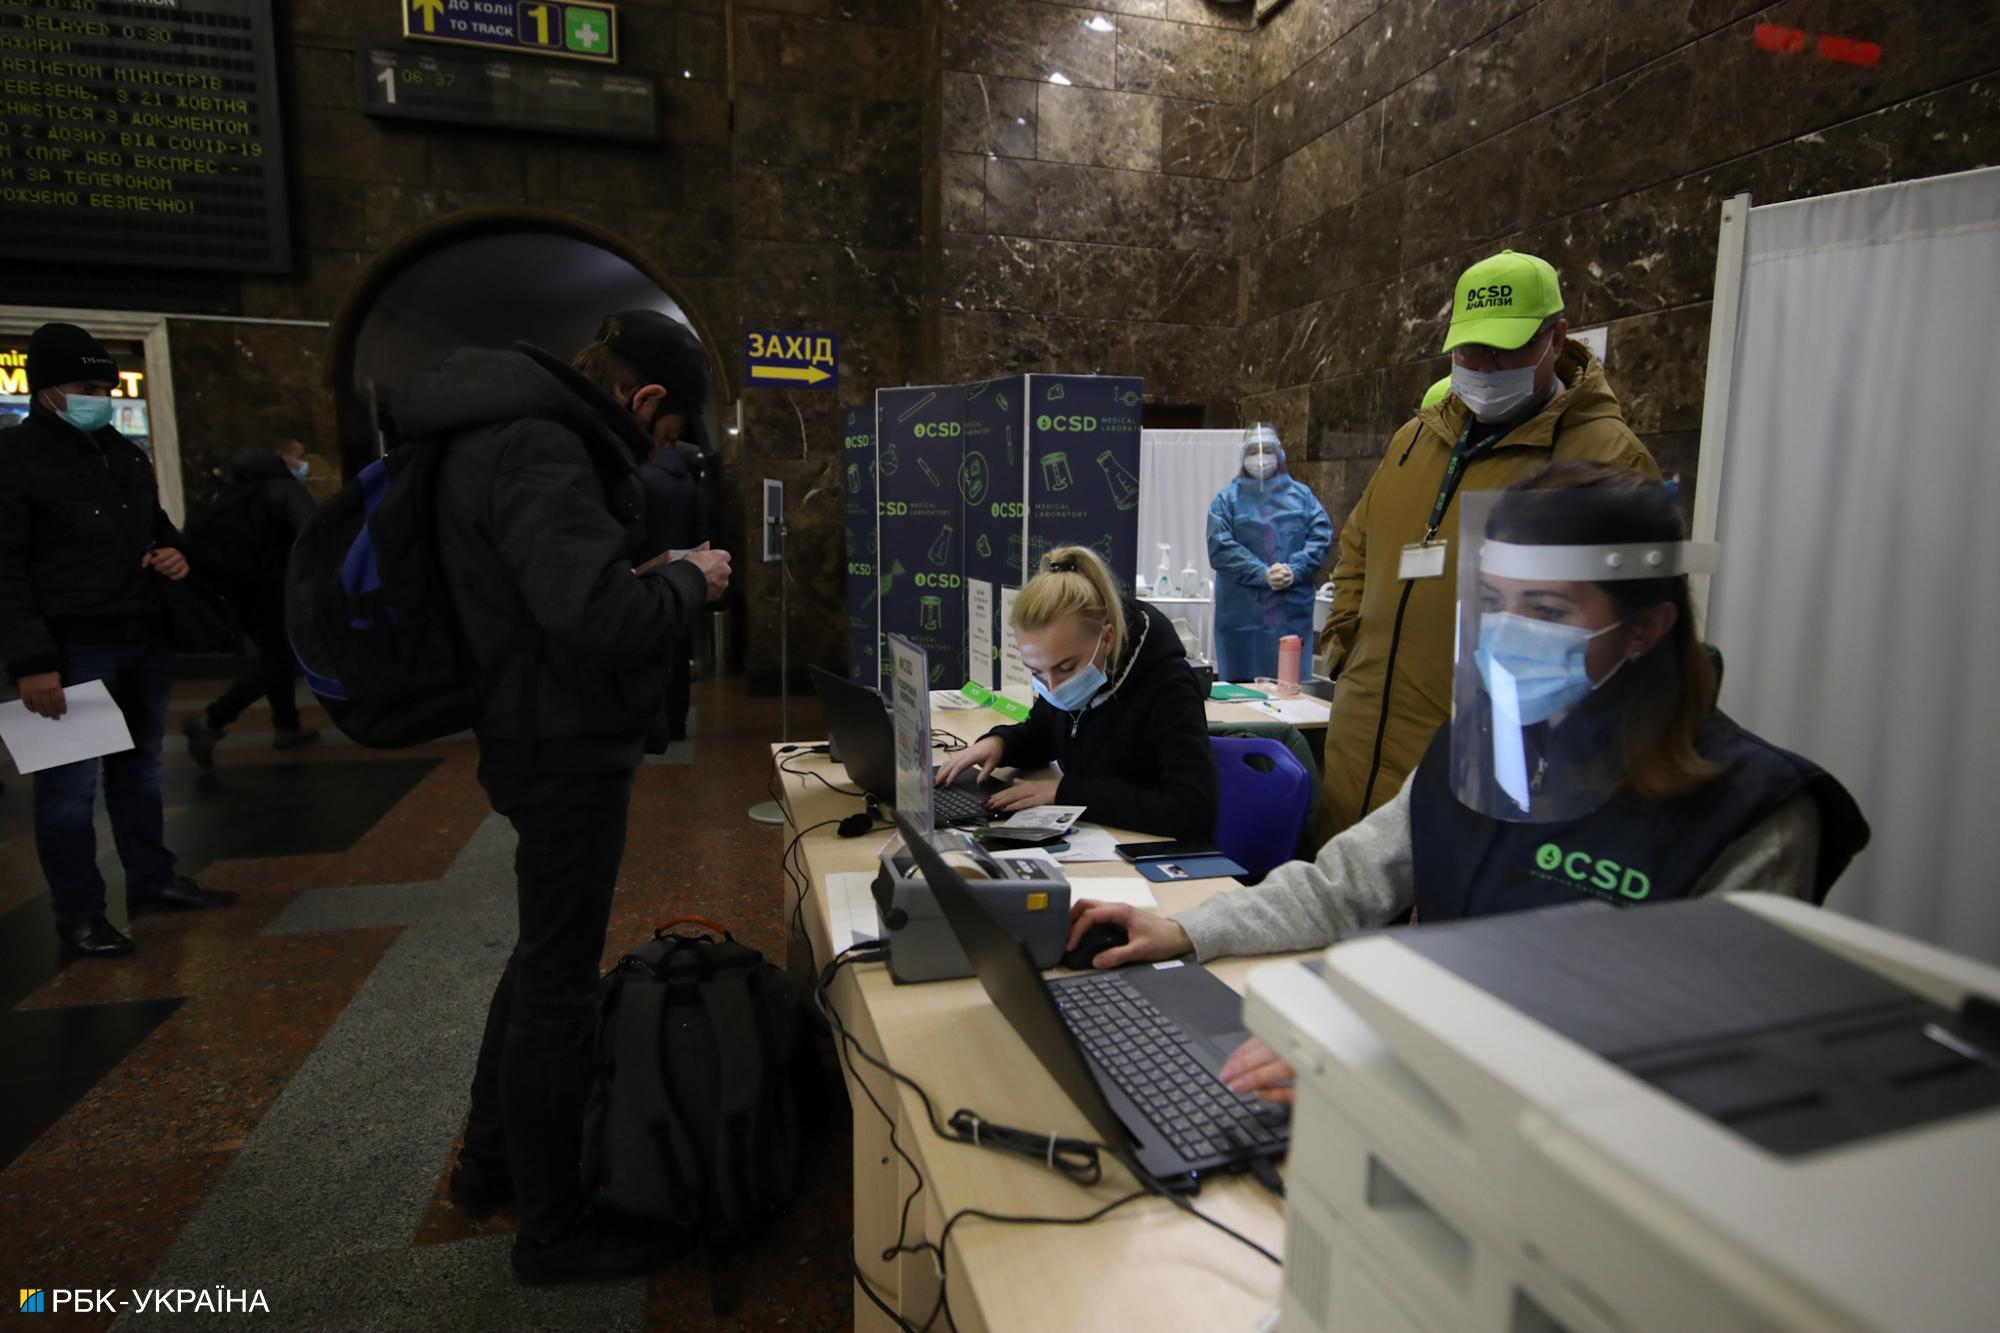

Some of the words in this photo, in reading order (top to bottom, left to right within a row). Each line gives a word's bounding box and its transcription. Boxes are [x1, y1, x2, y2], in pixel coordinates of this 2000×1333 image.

[448, 0, 469, 10] ДО
[23, 15, 111, 36] DELAYED
[449, 19, 468, 31] TO
[471, 22, 514, 37] TRACK
[528, 5, 549, 44] 1
[114, 66, 222, 91] МІНІСТРІВ
[377, 67, 396, 104] 1
[141, 91, 162, 106] 21
[177, 95, 247, 114] ЖОВТНЯ
[132, 111, 249, 135] ДОКУМЕНТОМ
[22, 124, 33, 138] 2
[120, 131, 156, 149] ВІД
[86, 150, 122, 167] АБО
[134, 155, 218, 174] ЕКСПРЕС
[25, 167, 52, 182] ЗА
[64, 169, 173, 192] ТЕЛЕФОНОМ
[89, 192, 194, 214] БЕЗПЕЧНО!
[1466, 297, 1513, 311] АНАЛІЗИ
[748, 333, 834, 367] ЗАХІД
